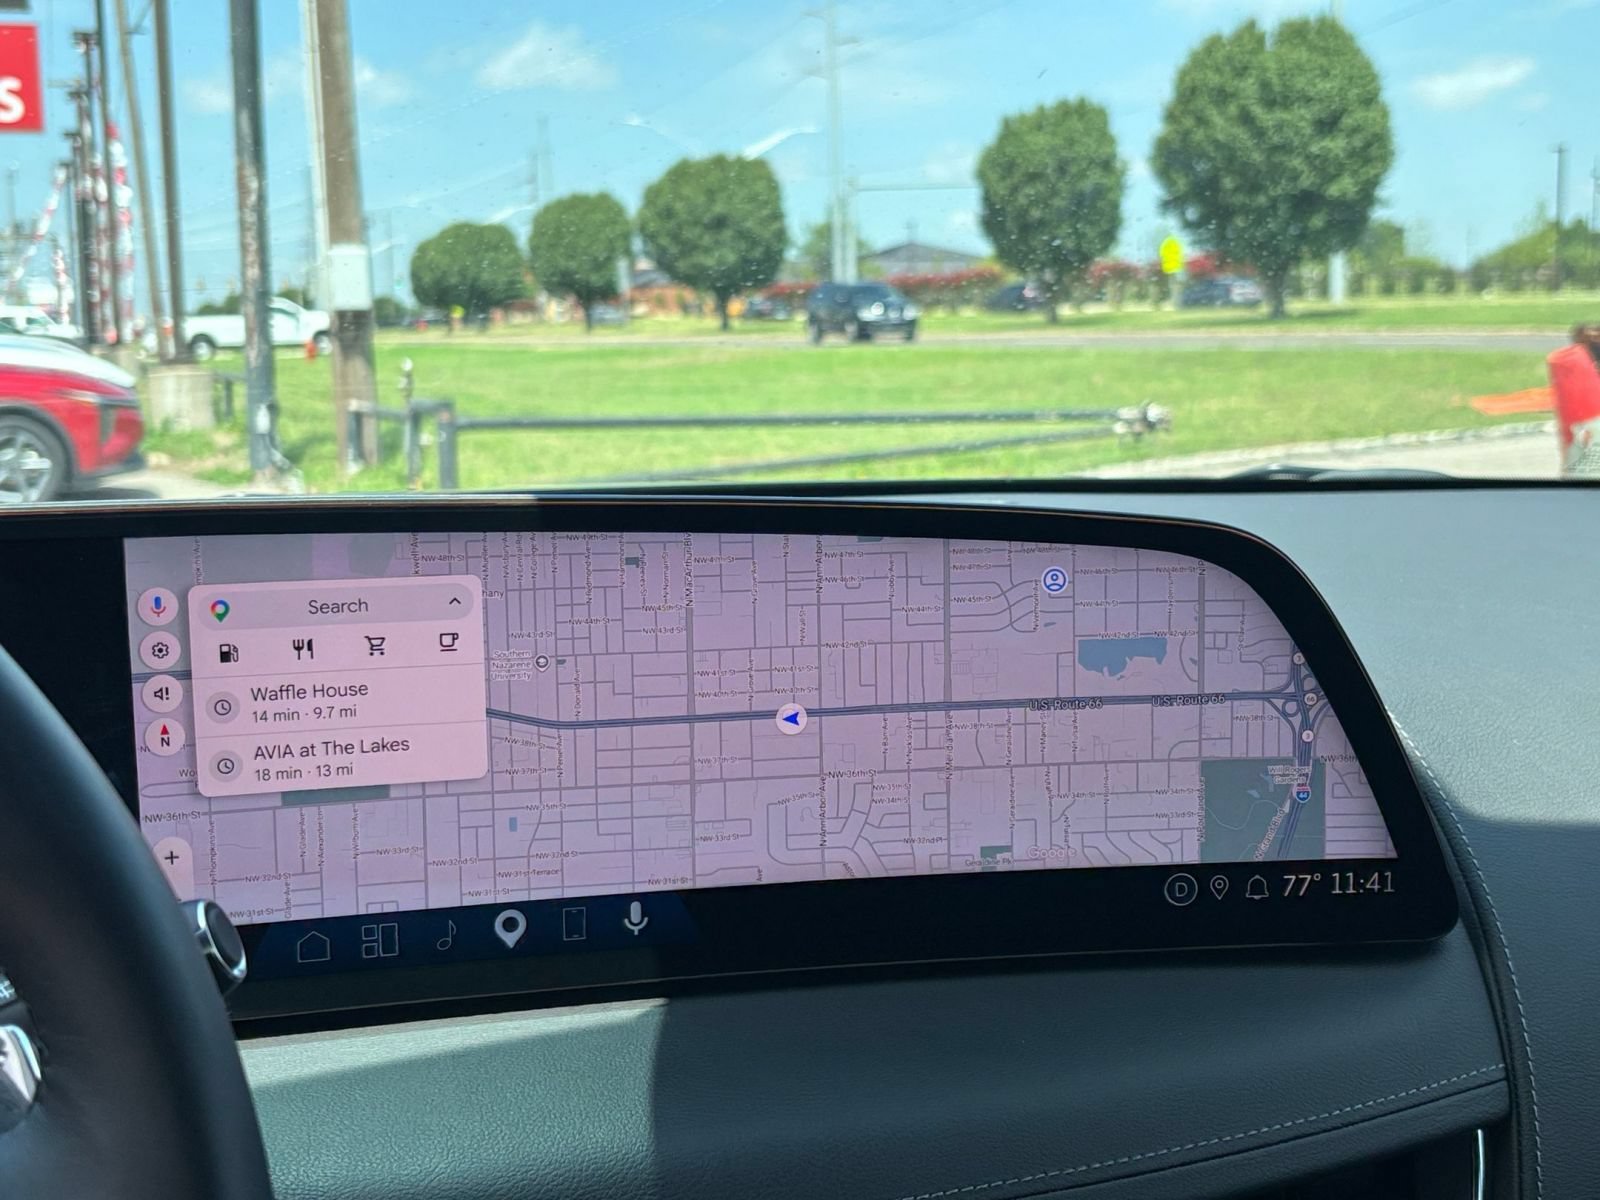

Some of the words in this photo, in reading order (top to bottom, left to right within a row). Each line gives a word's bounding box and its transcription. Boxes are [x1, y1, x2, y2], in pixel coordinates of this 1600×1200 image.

[457, 552, 465, 560] St
[858, 550, 864, 558] St
[684, 551, 693, 597] MacArthur
[308, 599, 369, 615] Search
[676, 603, 683, 611] St
[686, 599, 693, 607] N
[603, 616, 610, 624] St
[546, 631, 553, 639] St
[859, 640, 867, 648] St
[494, 649, 531, 659] Southern
[492, 660, 531, 670] Nazarene
[491, 671, 531, 682] University
[729, 668, 736, 676] St
[250, 683, 307, 702] Waffle
[313, 682, 369, 699] House
[730, 690, 737, 698] St
[1053, 700, 1086, 711] Route
[1087, 699, 1103, 710] 66
[1177, 695, 1207, 707] Route
[1211, 694, 1225, 705] 66
[252, 709, 268, 724] 14
[273, 707, 300, 722] min
[313, 705, 335, 720] 9.7
[339, 703, 357, 718] mi
[162, 737, 171, 748] N
[253, 744, 295, 761] AVIA
[300, 743, 317, 758] at
[321, 739, 355, 756] The
[360, 736, 411, 755] Lakes
[255, 769, 271, 782] 18
[276, 766, 303, 781] min
[316, 764, 331, 778] 13
[336, 762, 354, 776] mi
[846, 770, 866, 778] 36th
[868, 769, 877, 777] St
[1269, 766, 1284, 774] Will
[1274, 775, 1305, 784] Gardens
[1089, 791, 1096, 799] St
[144, 814, 163, 825] NW
[165, 812, 187, 822] 36th
[191, 811, 201, 820] St
[393, 848, 409, 856] 33rd
[551, 852, 570, 860] 32nd
[571, 851, 578, 859] St
[1028, 845, 1078, 861] Google
[449, 859, 467, 867] 32nd
[469, 858, 477, 866] St
[1002, 858, 1012, 866] Pk
[261, 873, 282, 882] 32nd
[283, 872, 291, 880] St
[530, 869, 559, 878] Terrace
[1283, 872, 1322, 897] 77°
[1331, 872, 1395, 896] 11:41
[502, 888, 510, 896] St
[1176, 883, 1188, 897] D
[246, 911, 265, 919] 31st
[266, 909, 274, 917] St
